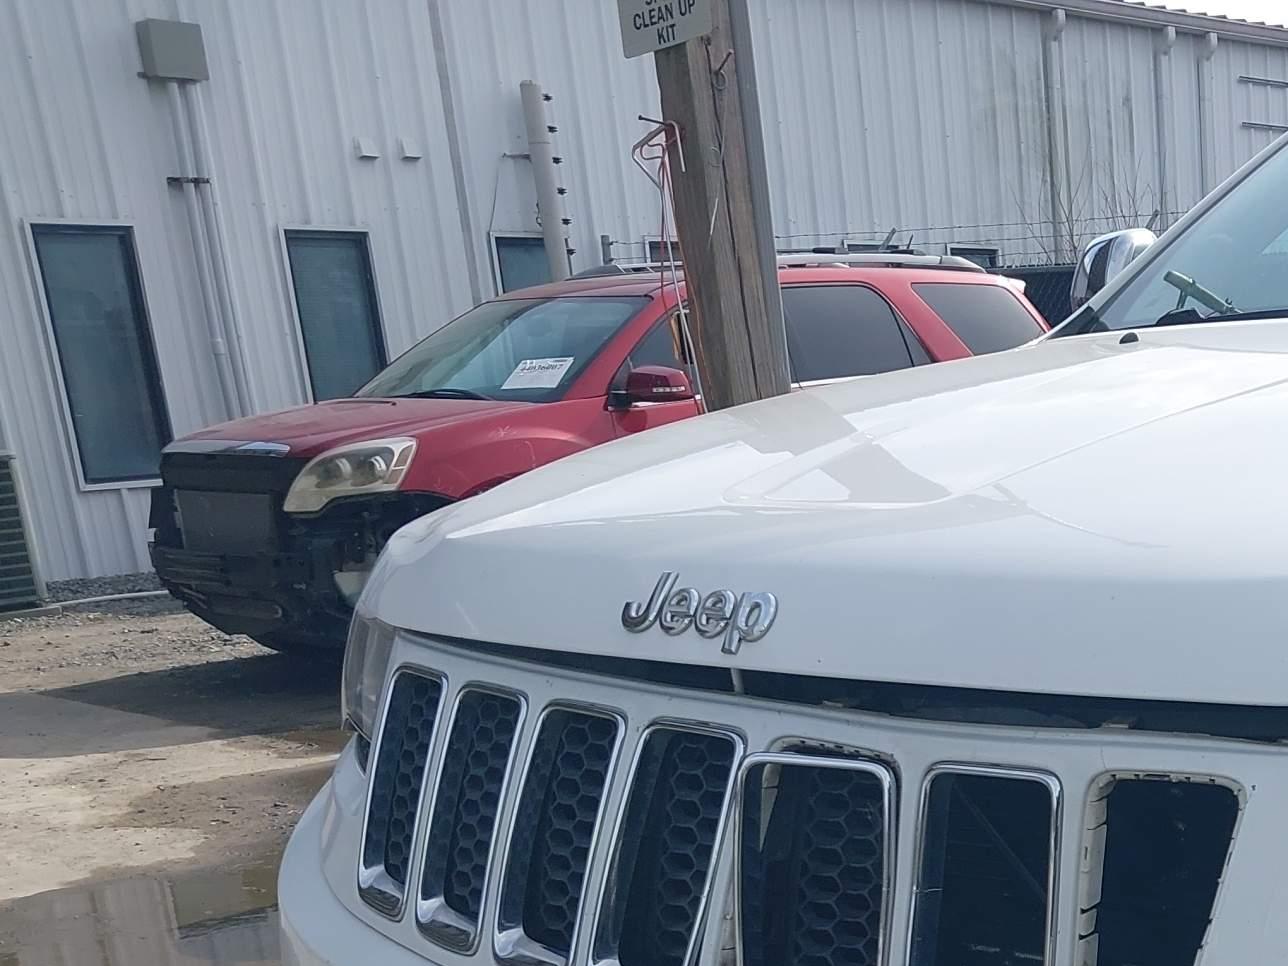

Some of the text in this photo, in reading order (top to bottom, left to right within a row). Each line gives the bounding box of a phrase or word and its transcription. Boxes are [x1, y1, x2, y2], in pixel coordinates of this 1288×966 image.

[633, 0, 696, 31] CLEAN UP
[656, 24, 677, 45] KIT
[621, 570, 779, 655] Jeep
